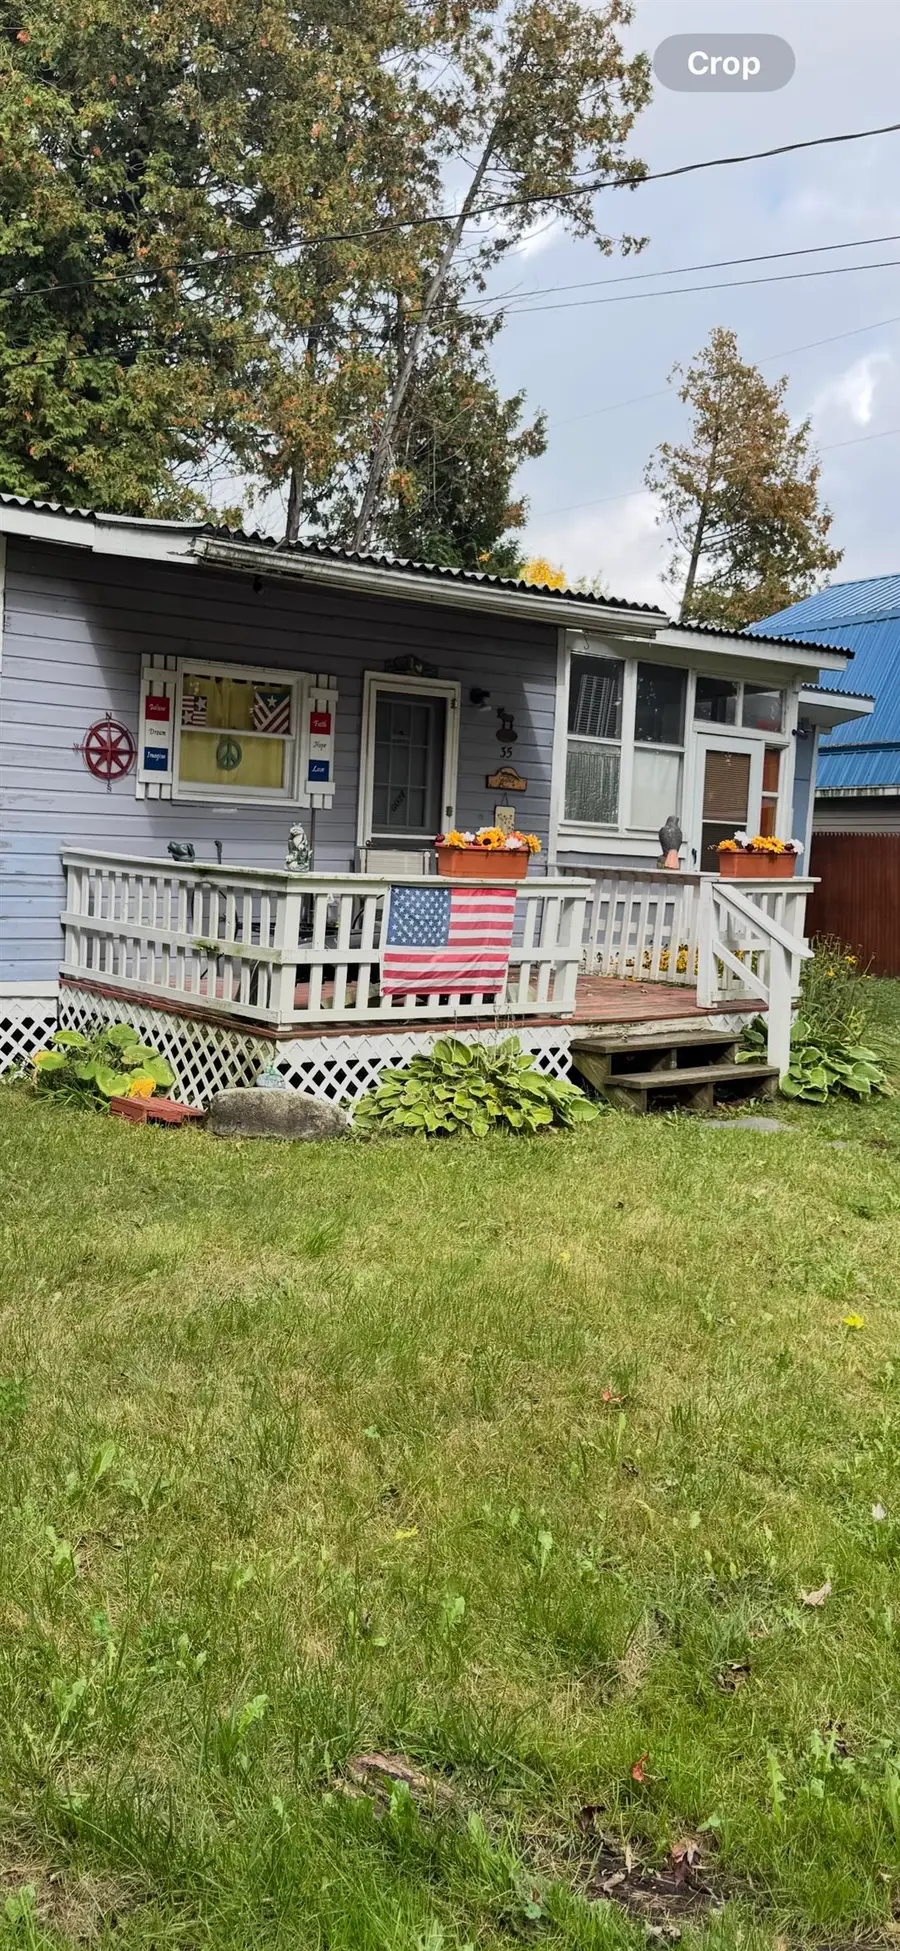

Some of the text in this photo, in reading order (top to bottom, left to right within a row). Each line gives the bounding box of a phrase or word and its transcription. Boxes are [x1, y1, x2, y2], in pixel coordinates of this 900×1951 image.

[148, 728, 166, 736] Dream
[147, 751, 166, 762] Imagine
[499, 746, 513, 759] 35
